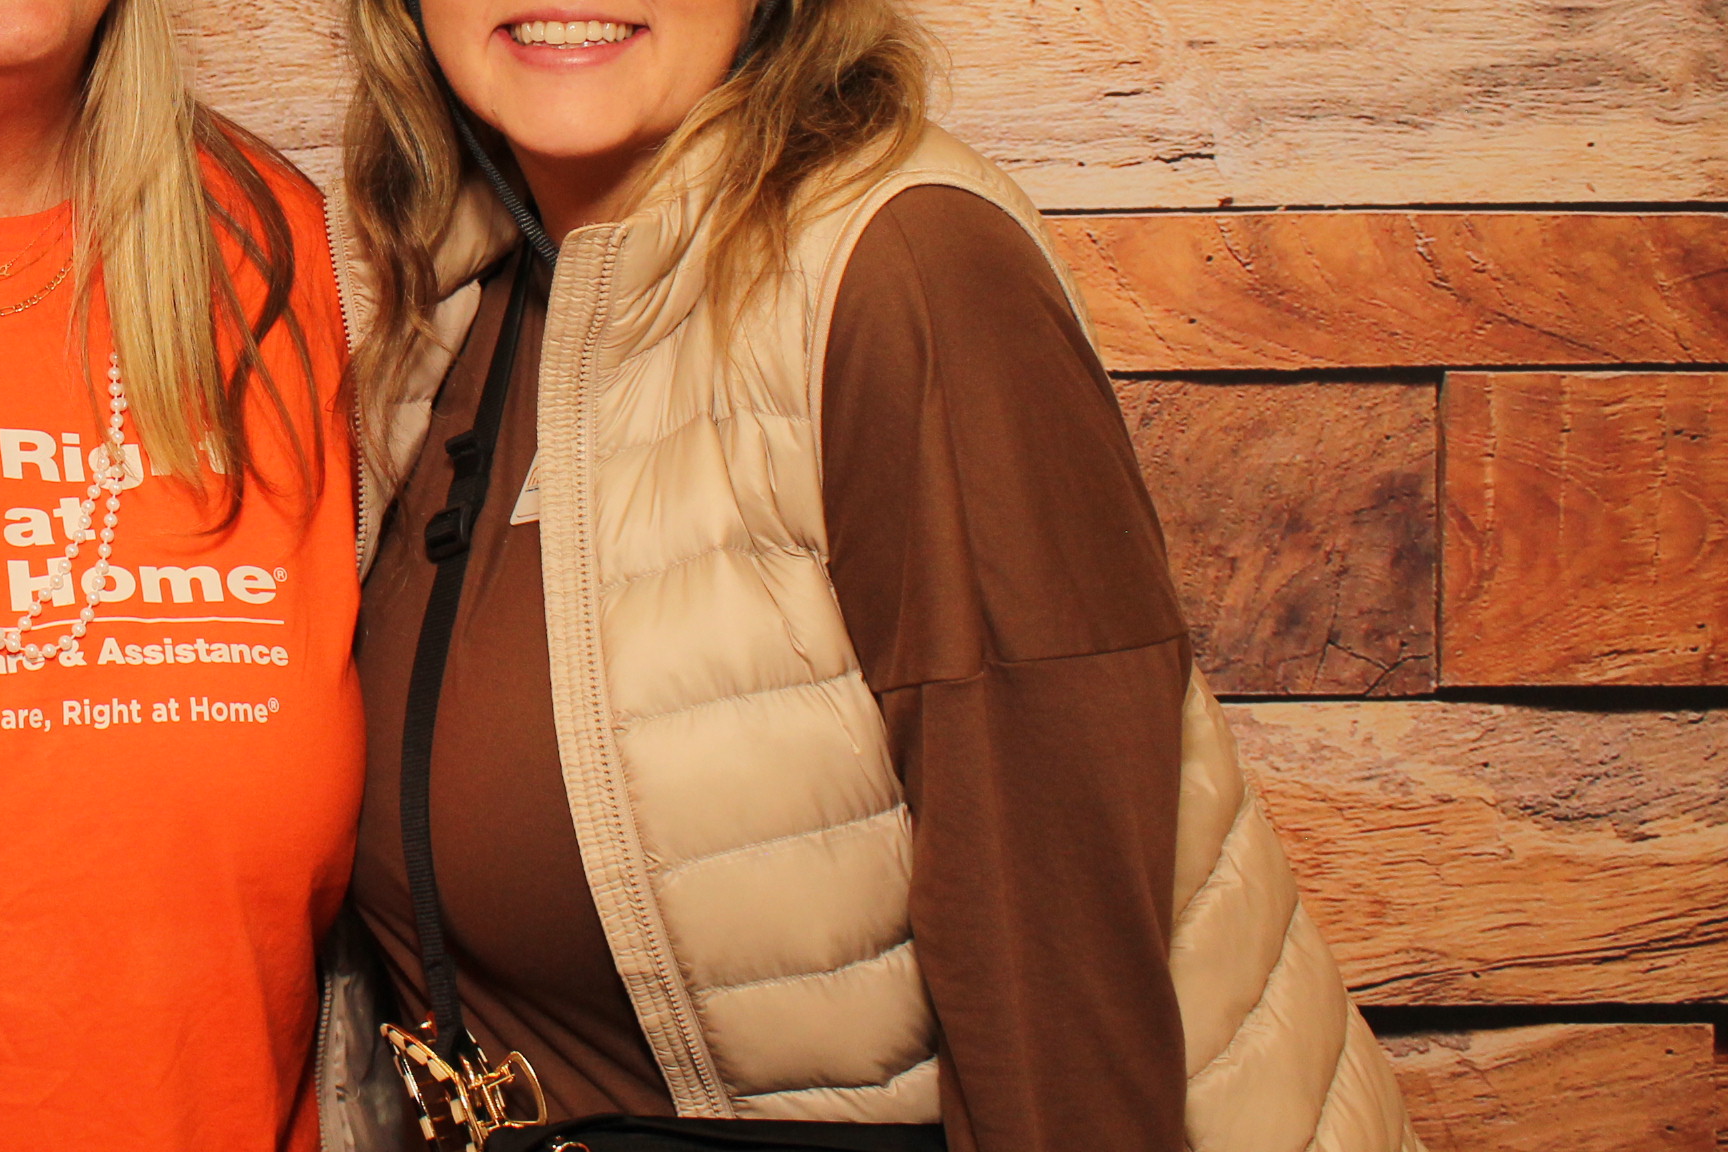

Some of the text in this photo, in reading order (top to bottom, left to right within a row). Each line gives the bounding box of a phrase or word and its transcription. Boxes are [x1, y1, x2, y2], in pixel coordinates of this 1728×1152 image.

[3, 497, 96, 547] at
[58, 639, 87, 667] &
[97, 637, 289, 666] Assistance
[62, 698, 142, 729] Right
[151, 697, 181, 723] at
